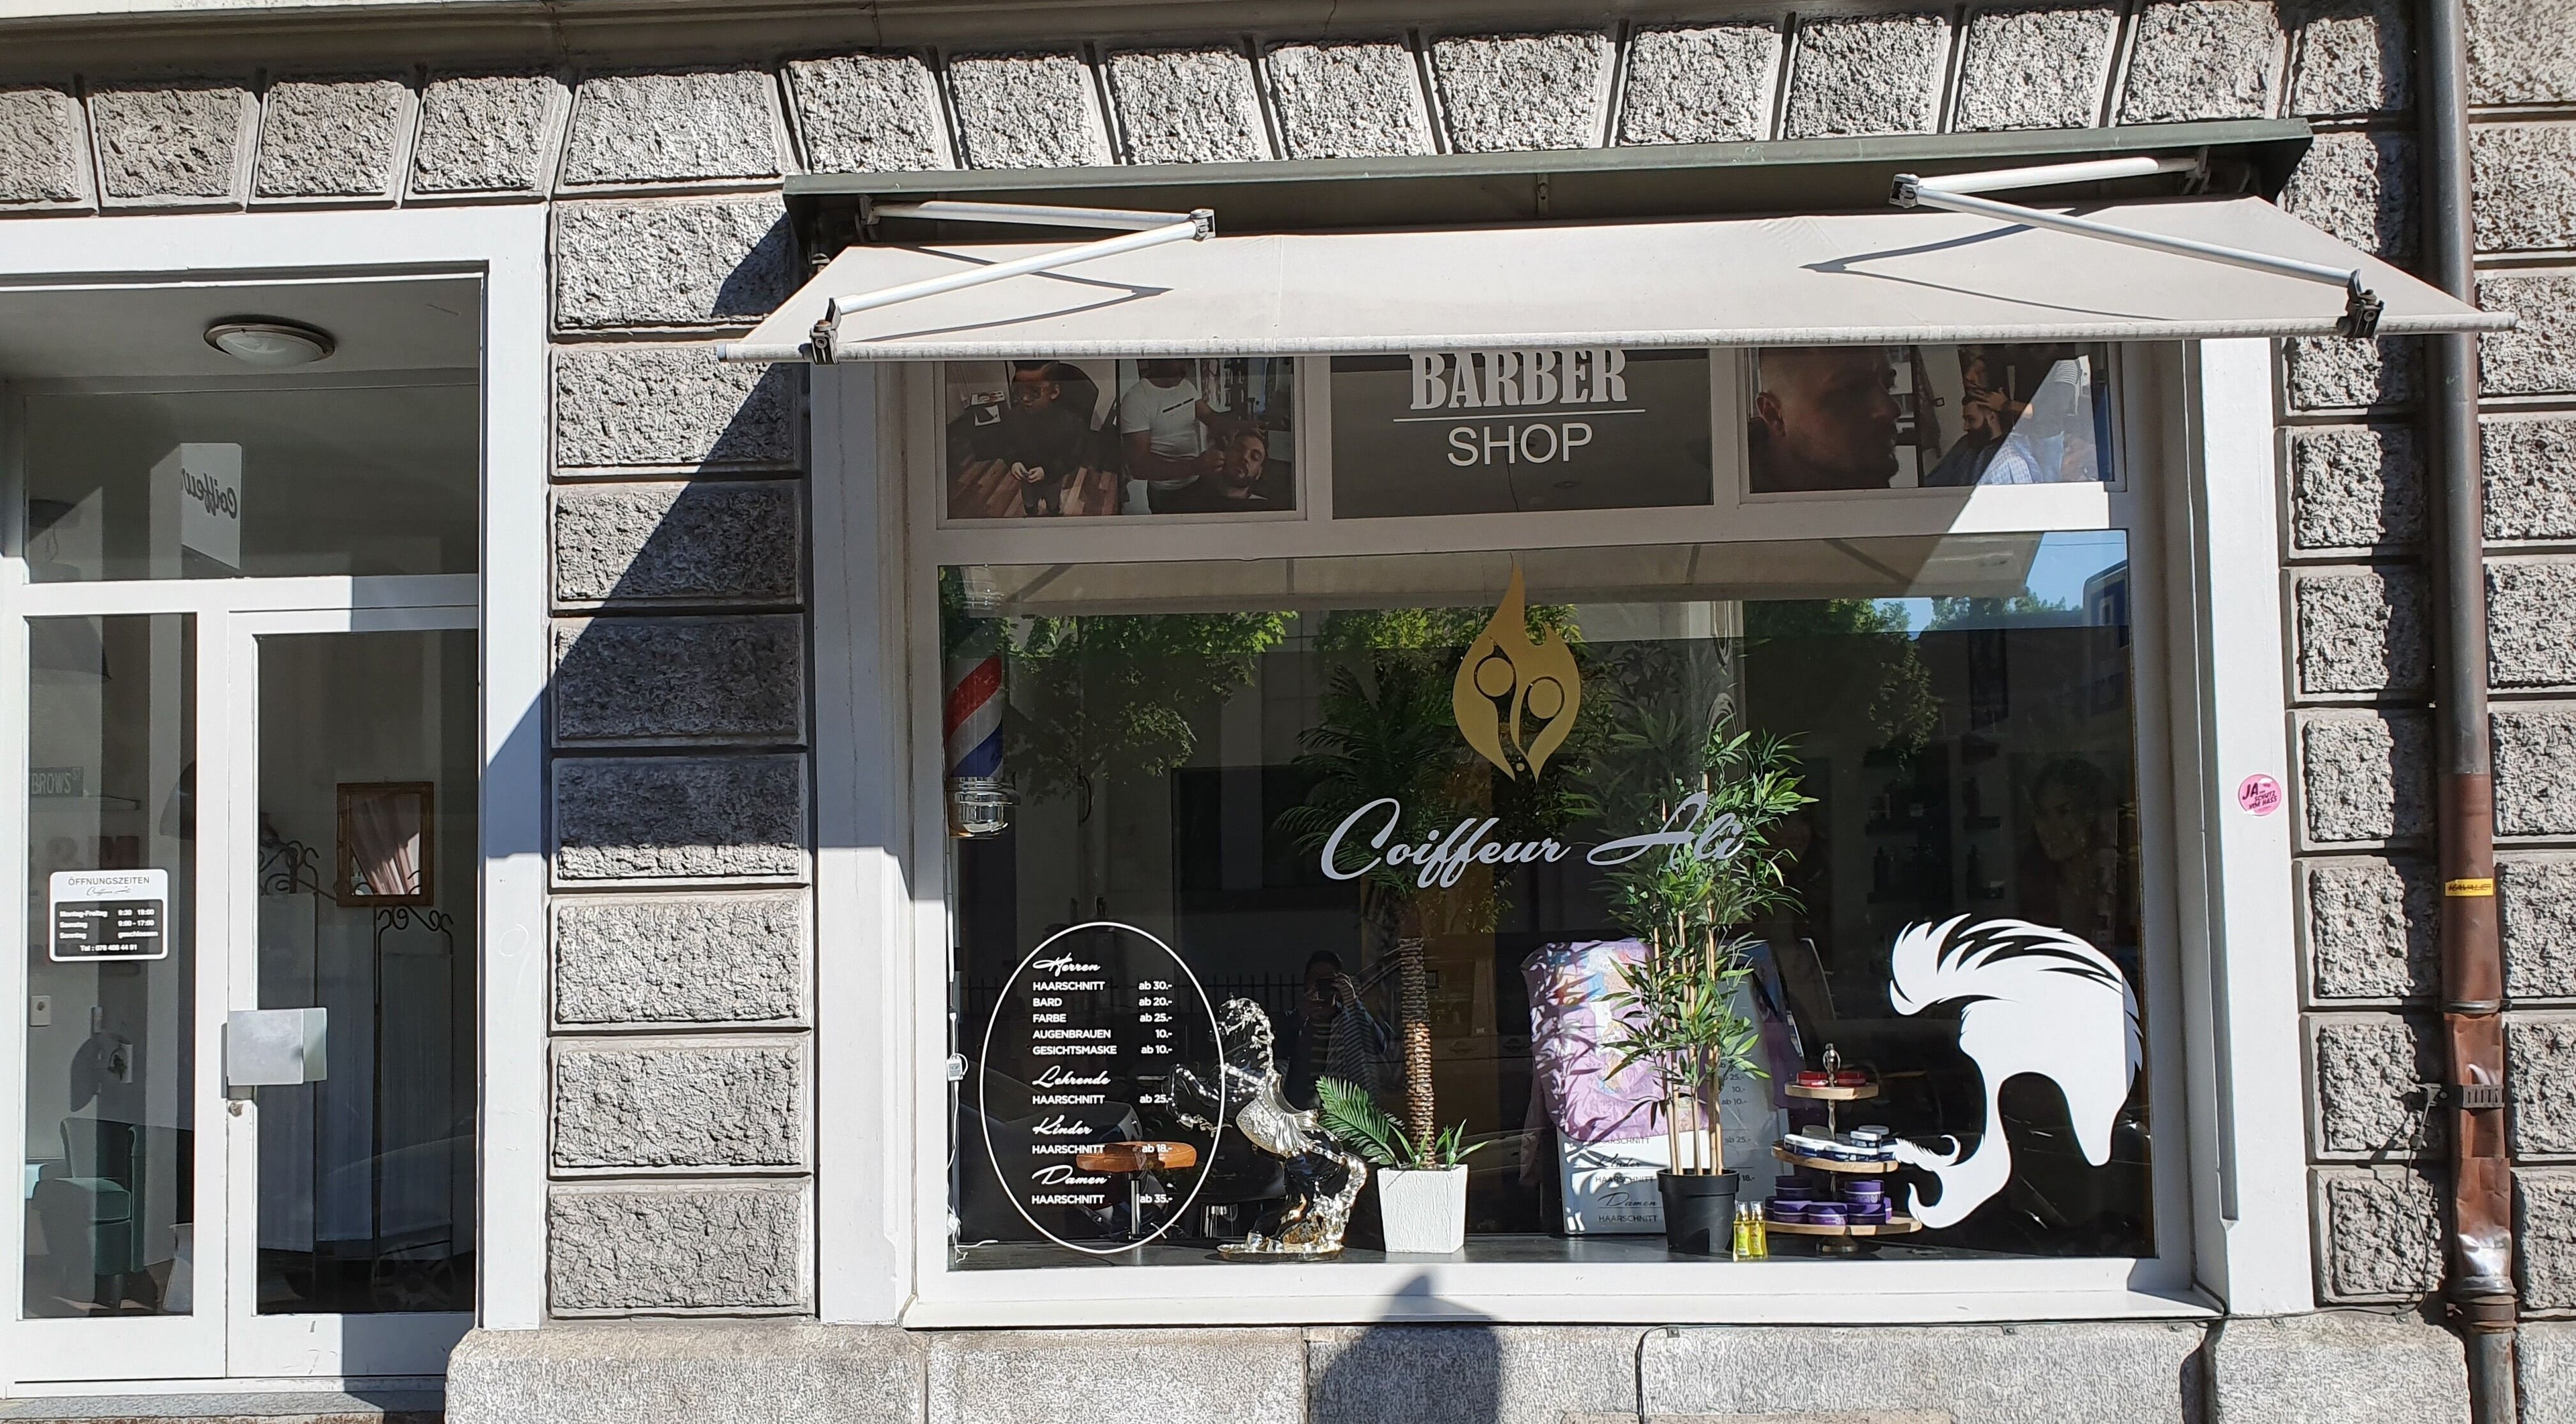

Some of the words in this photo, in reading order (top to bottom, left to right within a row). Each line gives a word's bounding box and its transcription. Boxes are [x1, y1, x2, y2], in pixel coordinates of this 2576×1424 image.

[1409, 347, 1627, 410] BARBER
[1447, 423, 1593, 466] SHOP
[2242, 782, 2259, 800] JA
[1320, 797, 1571, 889] Coiffeur
[1586, 791, 1744, 870] Ali
[68, 876, 150, 886] ÖFFNUNGSZEITEN
[117, 930, 159, 939] geschlossen
[1032, 952, 1101, 977] Herren
[1032, 981, 1106, 991] HAARSCHNITT
[1138, 981, 1152, 990] ab
[1153, 981, 1173, 990] 30.-
[1032, 997, 1063, 1007] BARD
[1138, 997, 1152, 1006] ab
[1153, 997, 1173, 1006] 20.-
[1032, 1014, 1067, 1023] FARBE
[1139, 1012, 1152, 1022] ab
[1154, 1013, 1173, 1022] 25.-
[1032, 1029, 1111, 1039] AUGENBRAUEN
[1155, 1029, 1173, 1038] 10.-
[1032, 1045, 1118, 1055] GESICHTSMASKE
[1140, 1044, 1154, 1054] ab
[1155, 1044, 1173, 1054] 10.-
[1032, 1064, 1112, 1089] Lehrende
[1032, 1095, 1106, 1105] HAARSCHNITT
[1139, 1094, 1152, 1104] ab
[1154, 1094, 1173, 1103] 25.-
[1032, 1114, 1093, 1136] Kinder
[1032, 1144, 1106, 1154] HAARSCHNITT
[1142, 1143, 1155, 1153] ab
[1156, 1144, 1173, 1153] 18.-
[1031, 1164, 1108, 1185] Damen
[1031, 1194, 1106, 1204] HAARSCHNITT
[1139, 1194, 1152, 1203] ab
[1154, 1194, 1173, 1203] 35.-
[1597, 1191, 1657, 1207] Damen
